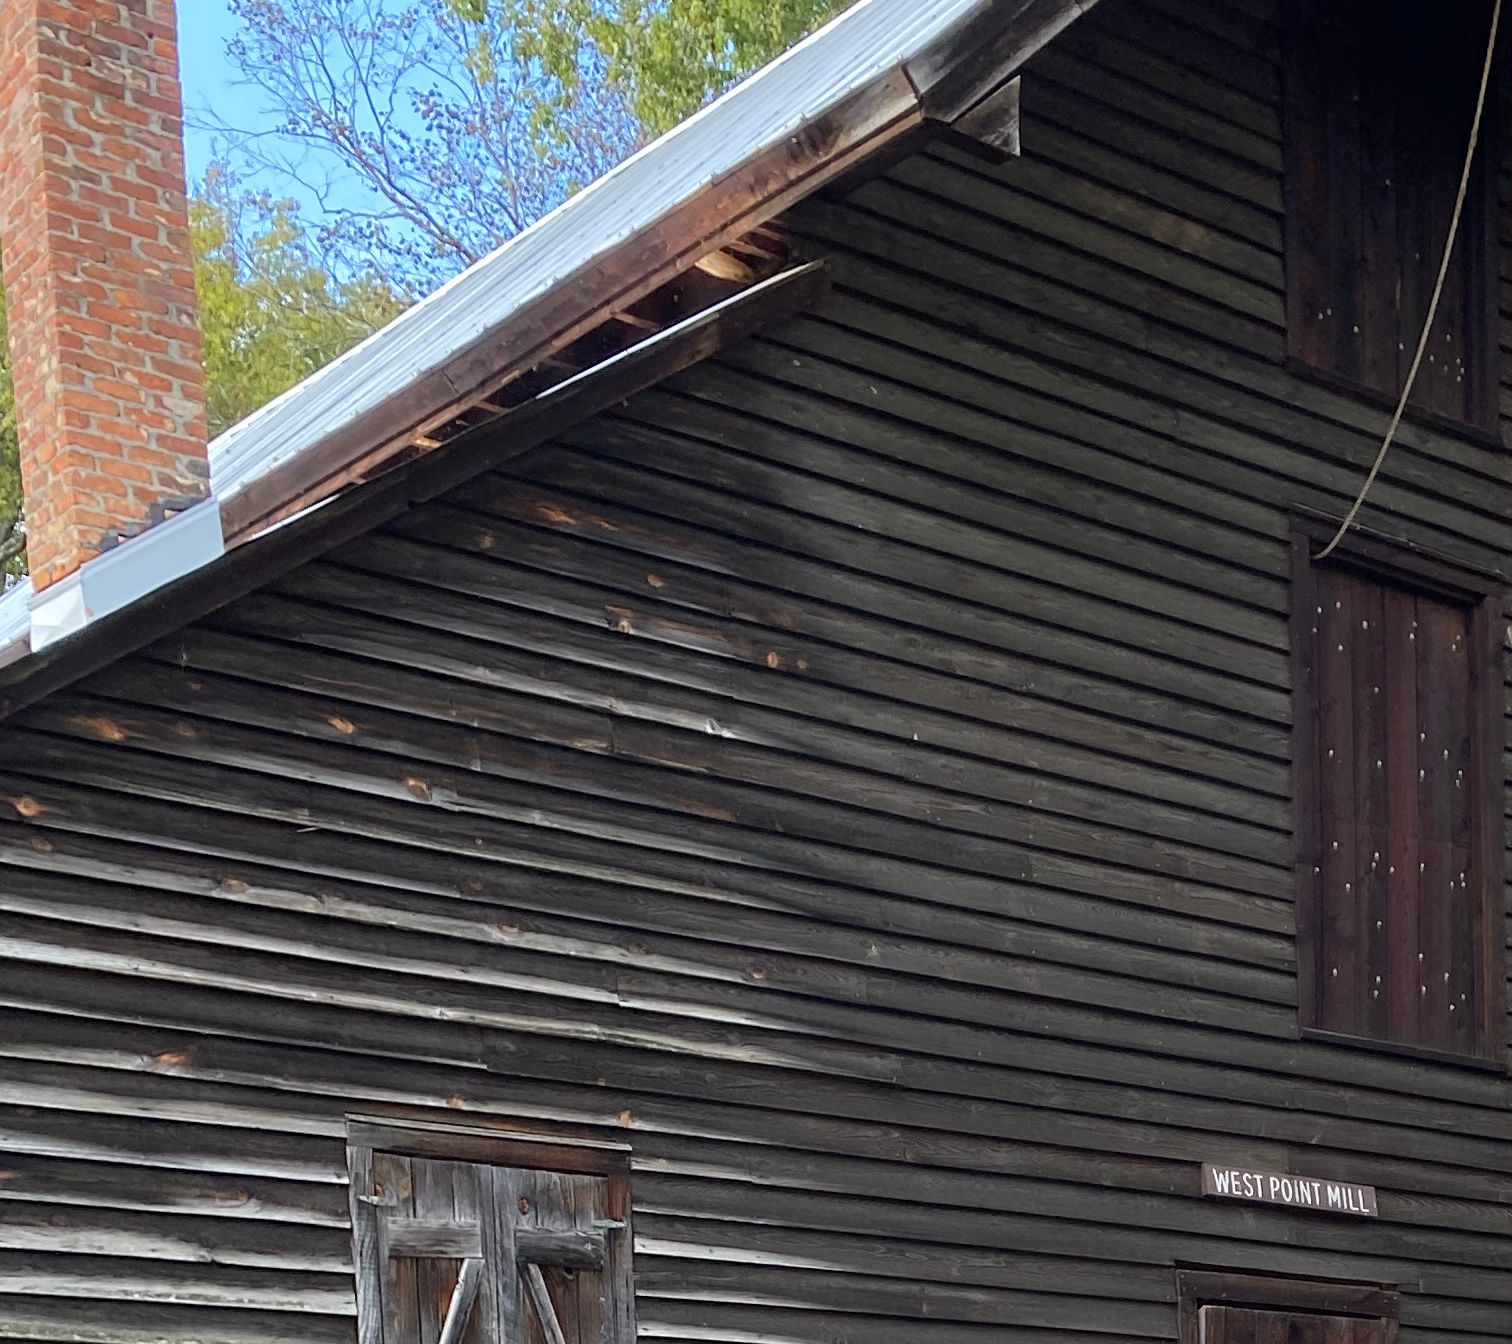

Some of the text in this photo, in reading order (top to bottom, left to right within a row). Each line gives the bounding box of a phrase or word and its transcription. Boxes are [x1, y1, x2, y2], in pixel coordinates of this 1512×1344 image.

[1213, 1168, 1370, 1212] WEST POINT MILL
